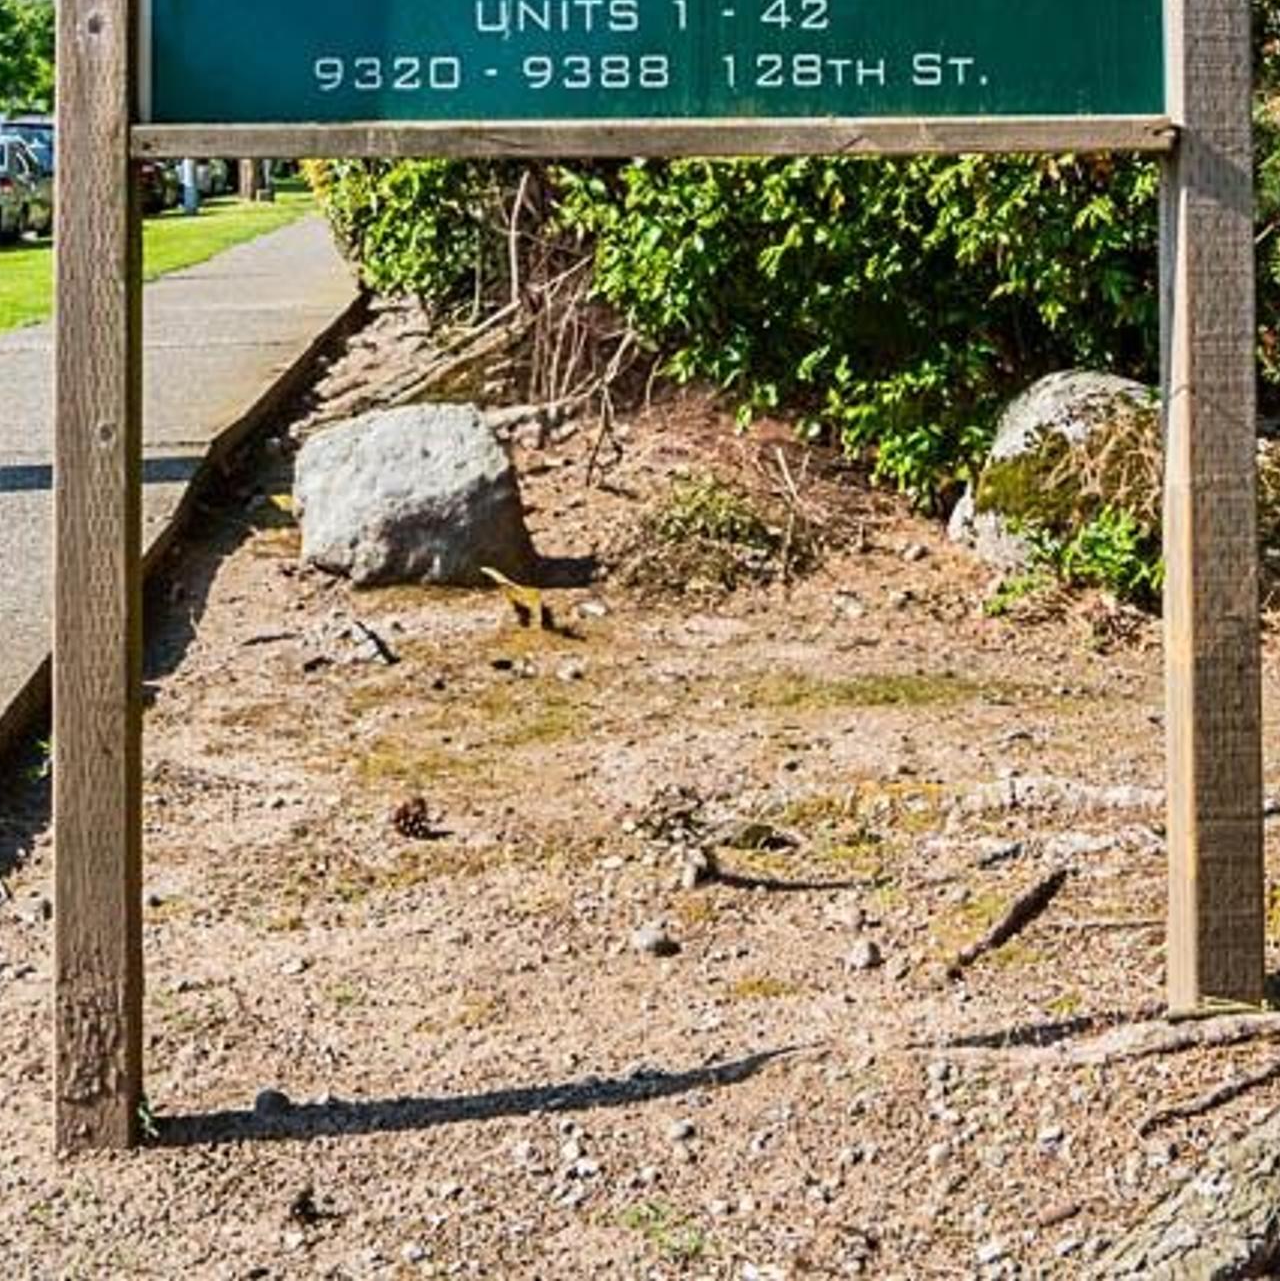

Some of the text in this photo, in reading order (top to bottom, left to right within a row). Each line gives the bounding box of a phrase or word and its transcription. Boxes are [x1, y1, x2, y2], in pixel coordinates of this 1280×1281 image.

[670, 0, 687, 29] 1
[314, 55, 460, 90] 9320
[522, 55, 670, 89] 9388
